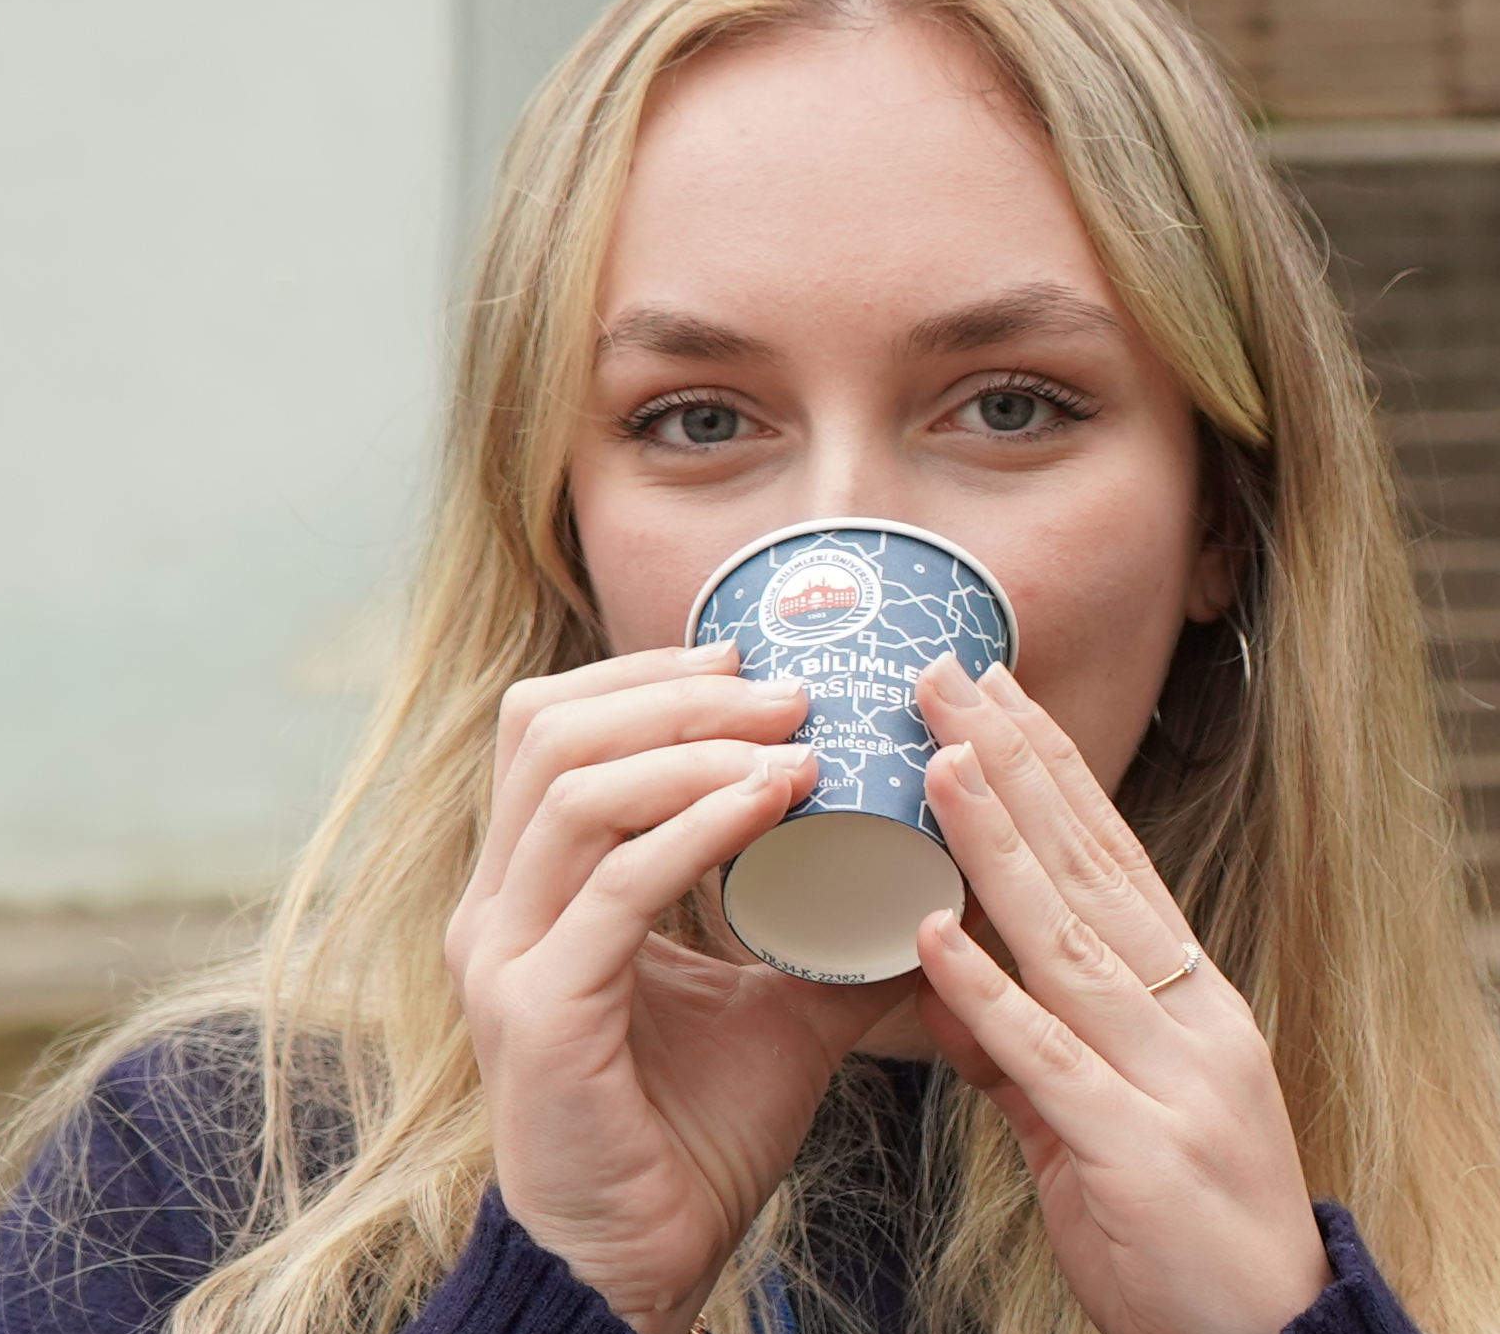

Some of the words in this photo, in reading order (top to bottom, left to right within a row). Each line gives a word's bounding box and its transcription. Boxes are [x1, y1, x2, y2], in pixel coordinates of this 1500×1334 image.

[801, 651, 921, 684] BİLİMLE
[803, 677, 911, 708] RSİTESİ
[788, 720, 870, 741] kiye'nin
[818, 776, 855, 788] du.tr
[760, 948, 865, 983] TR-34-K-223823
